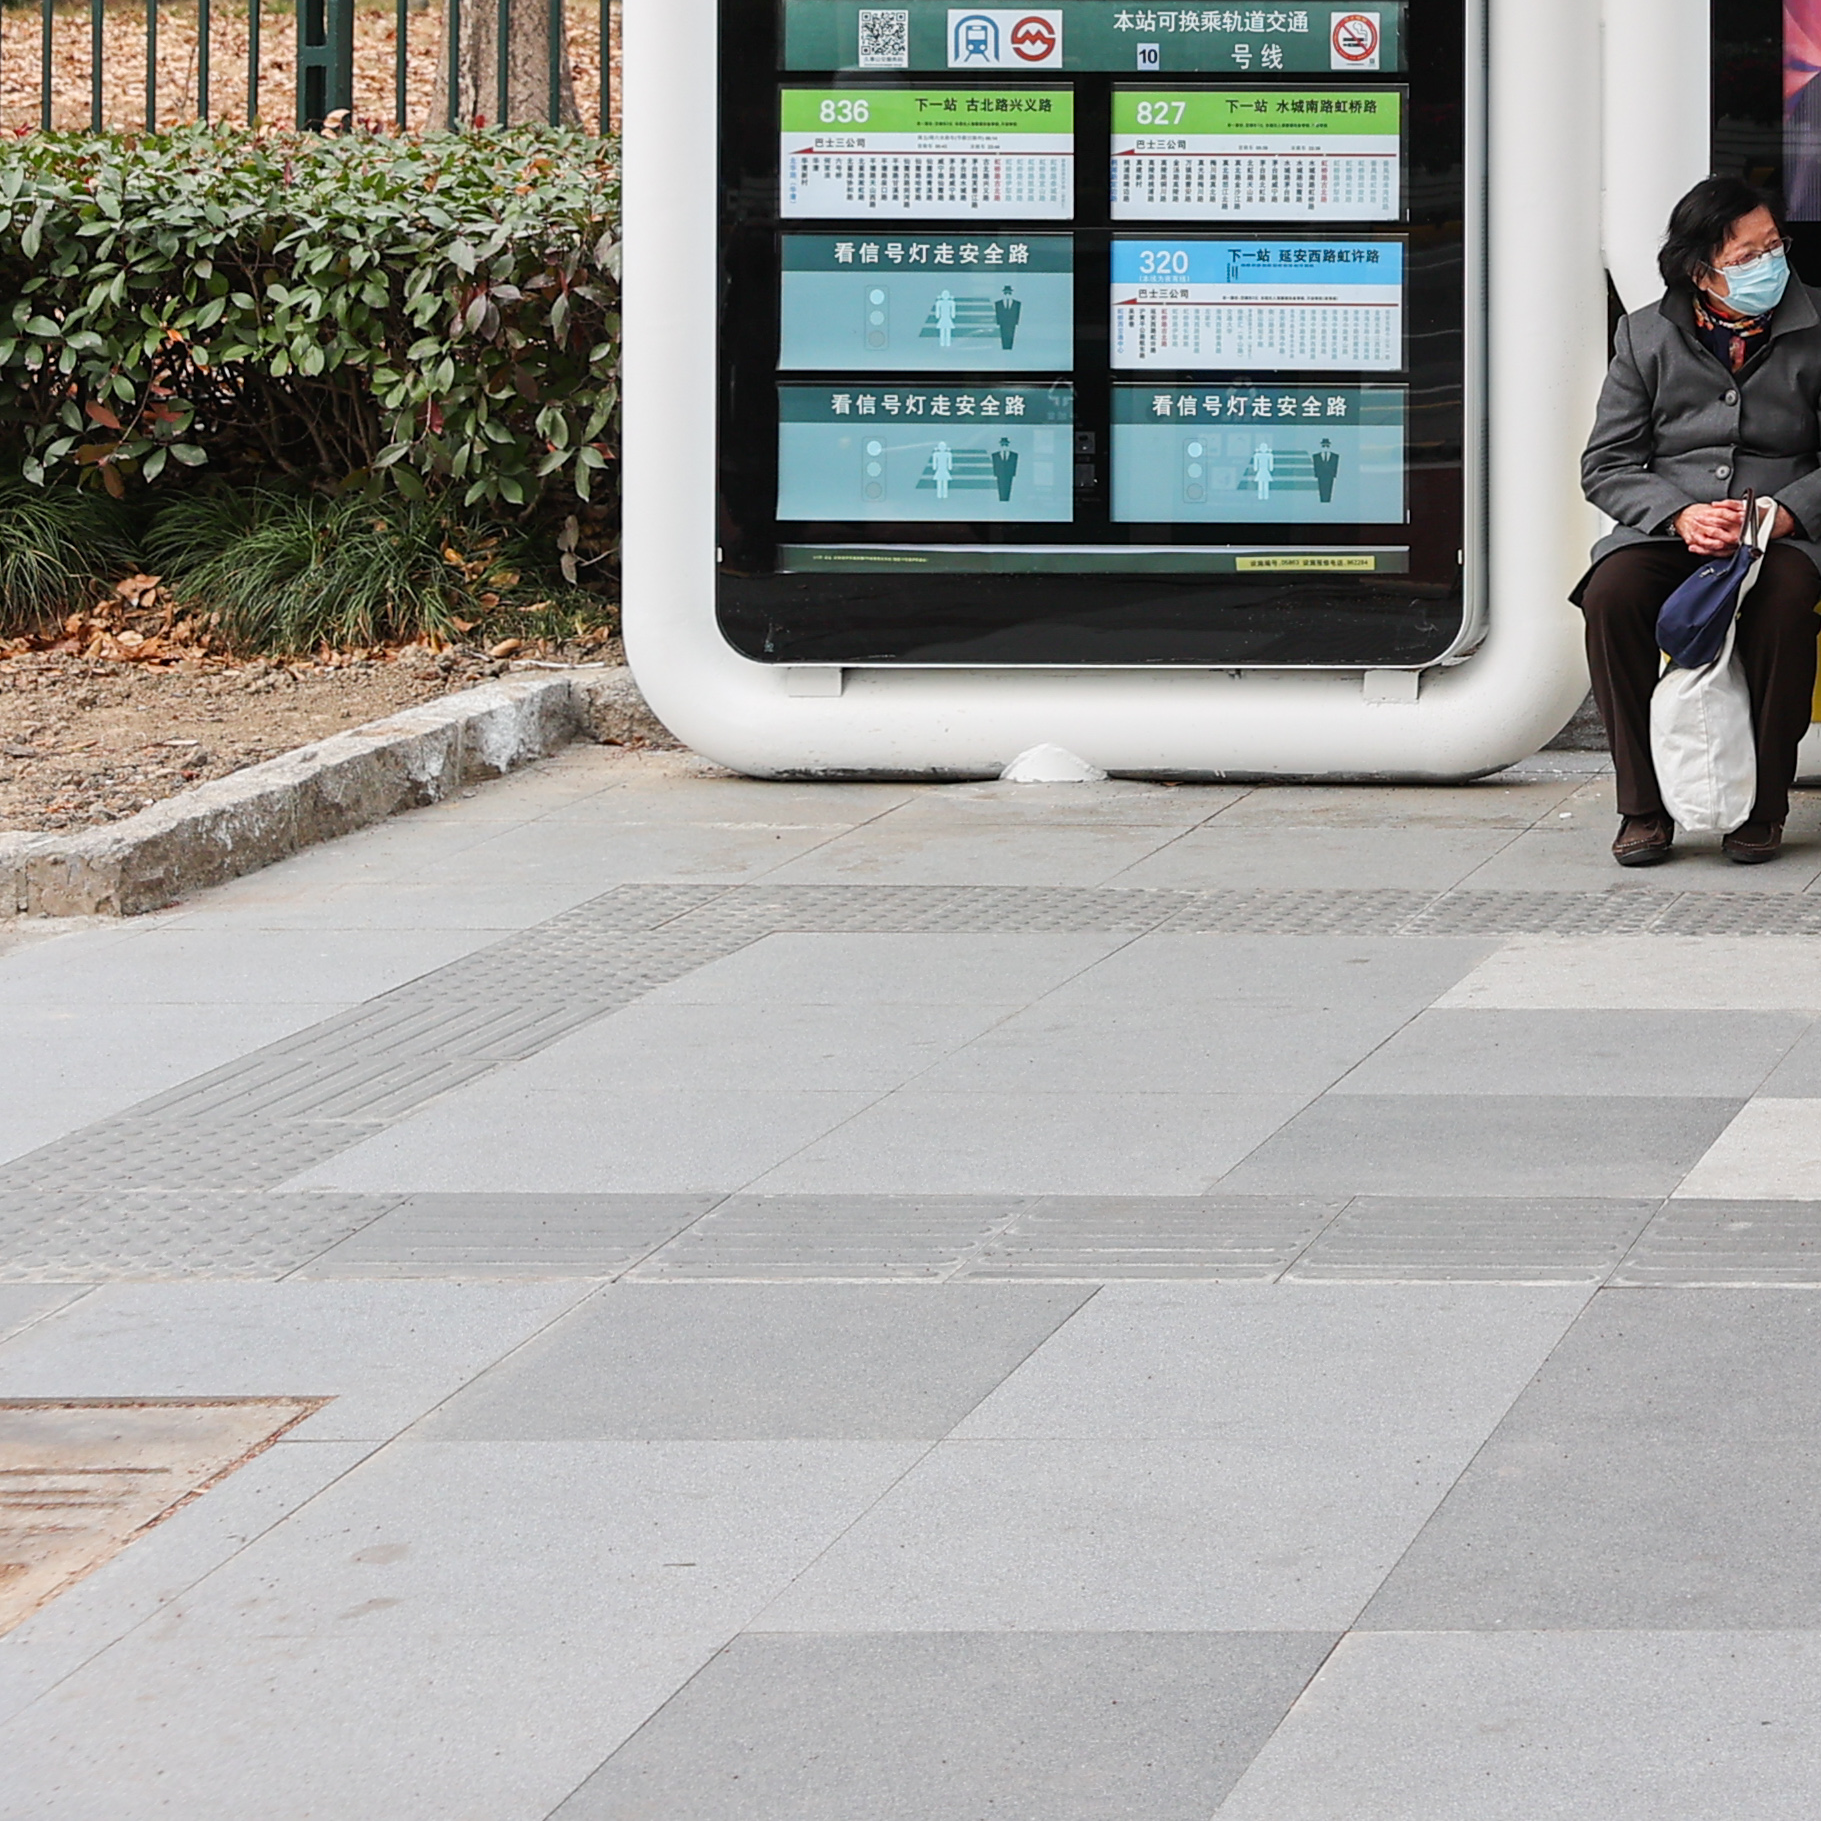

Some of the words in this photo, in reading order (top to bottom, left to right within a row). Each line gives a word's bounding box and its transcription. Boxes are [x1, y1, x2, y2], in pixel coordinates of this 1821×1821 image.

[1112, 9, 1309, 34] 本站可换乘轨道交通
[1138, 48, 1158, 64] 10
[819, 99, 870, 123] 836
[915, 97, 957, 113] 下一站
[965, 97, 1053, 113] 古北路兴义路
[1136, 101, 1187, 125] 827
[1225, 98, 1268, 114] 下一站
[1275, 98, 1378, 114] 水城南路虹桥路
[815, 138, 866, 148] 巴士三公司
[1136, 139, 1187, 150] 巴士三公司
[833, 242, 1031, 264] 看信号灯走安全路
[1139, 250, 1190, 275] 320
[1227, 248, 1270, 263] 下一站
[1278, 248, 1381, 264] 延安西路虹许路
[1138, 288, 1190, 299] 巴士三公司
[830, 394, 1027, 416] 看信号灯走安全路
[1152, 394, 1348, 418] 看信号灯走安全路
